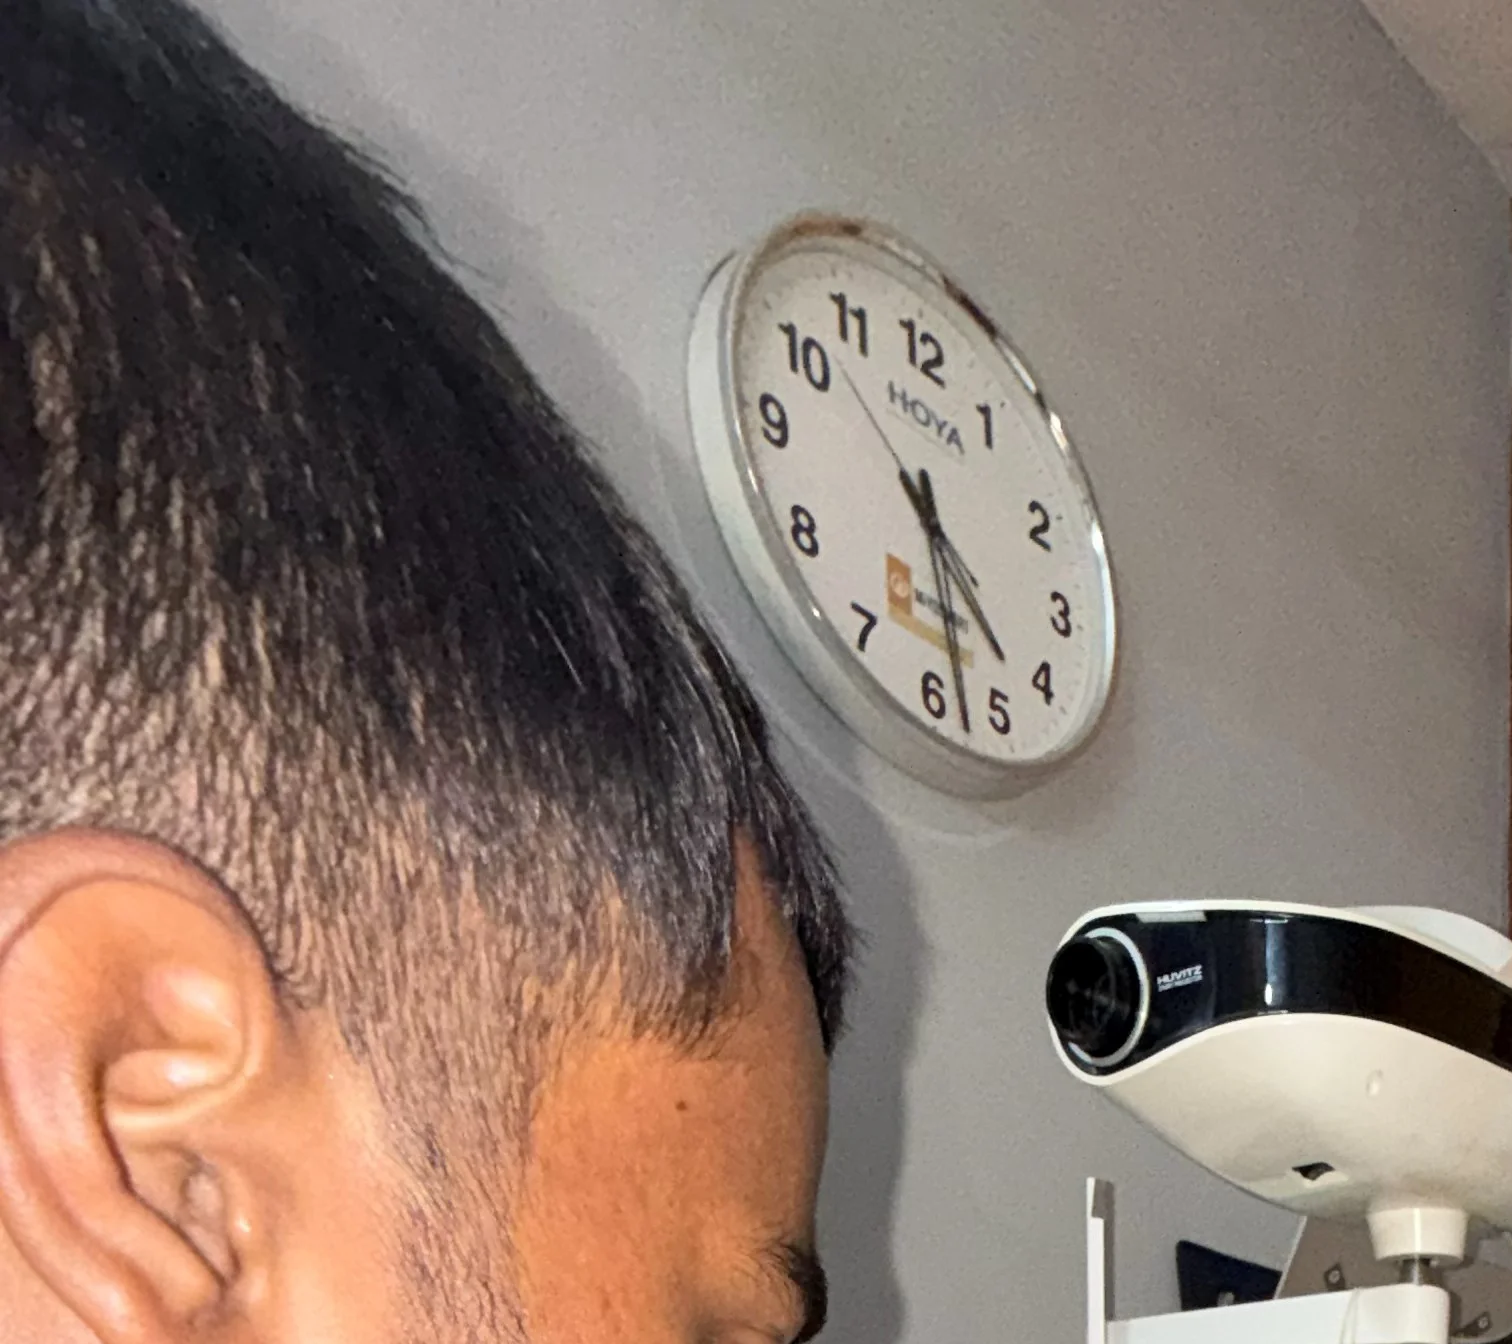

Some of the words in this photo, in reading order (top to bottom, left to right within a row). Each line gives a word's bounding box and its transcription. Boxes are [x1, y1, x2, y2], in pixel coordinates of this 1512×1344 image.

[829, 292, 868, 357] 11
[779, 321, 831, 393] 10
[899, 318, 945, 388] 12
[758, 392, 789, 449] 9
[886, 380, 966, 455] HOYA
[975, 403, 994, 449] 1
[790, 504, 820, 558] 8
[1028, 500, 1052, 552] 2
[850, 601, 878, 653] 7
[1049, 591, 1072, 638] 3
[920, 671, 947, 720] 6
[1031, 661, 1054, 706] 4
[988, 687, 1011, 735] 5
